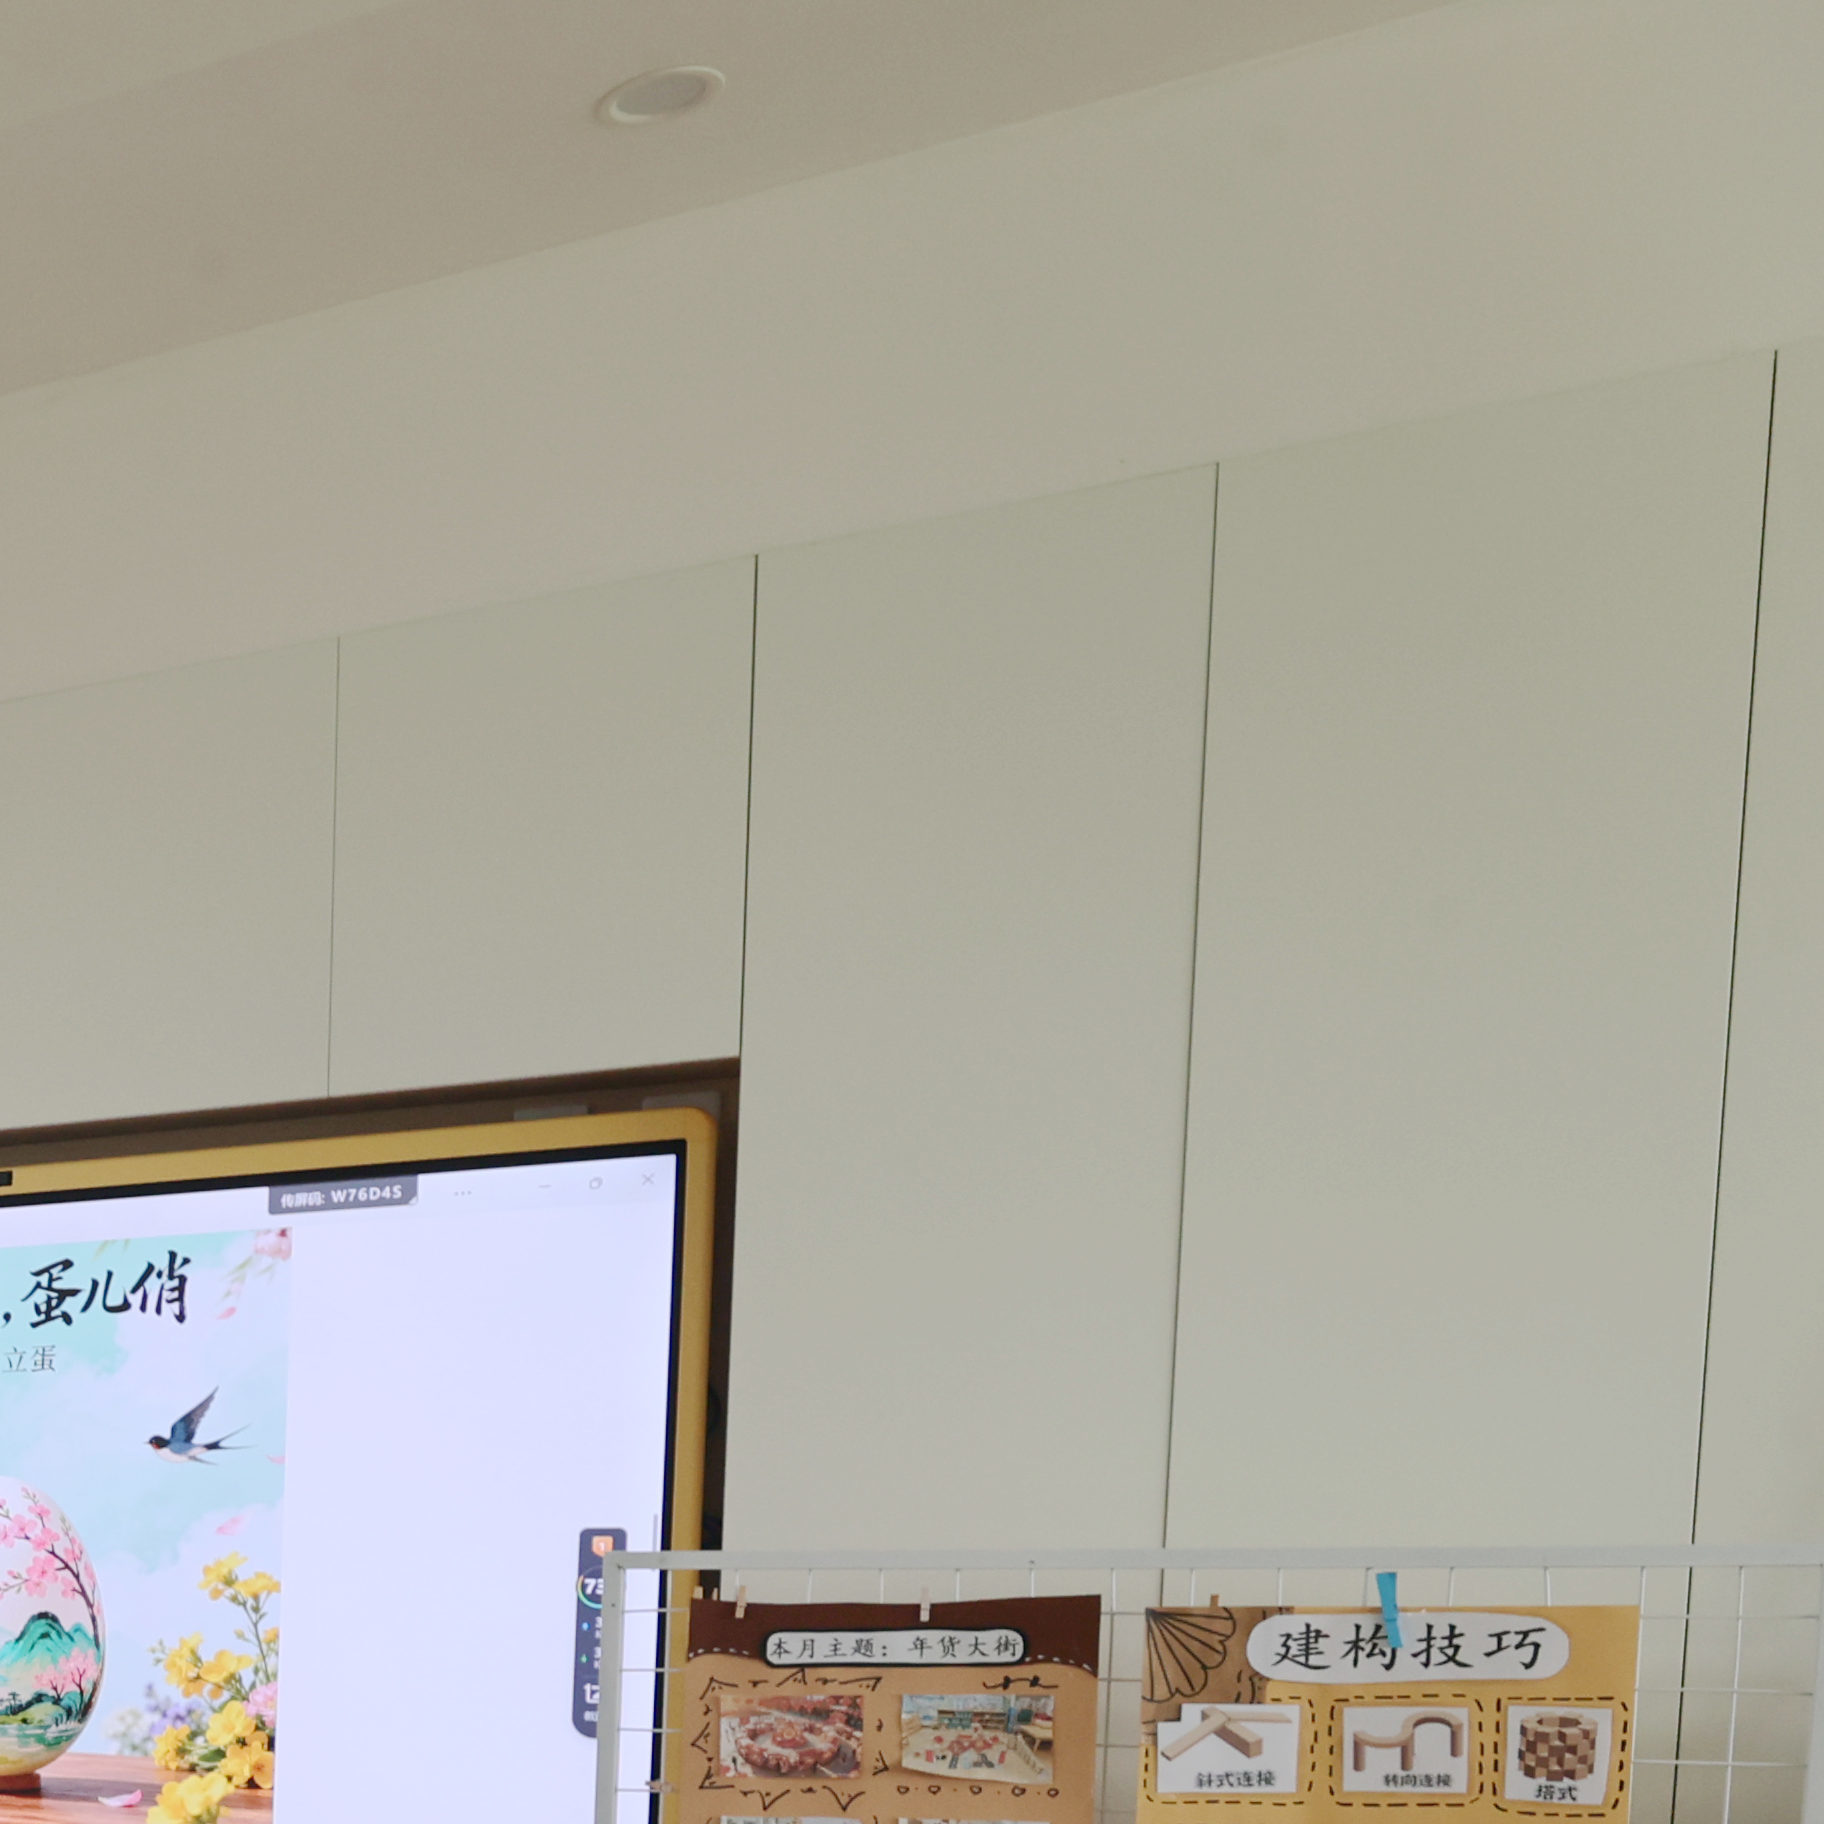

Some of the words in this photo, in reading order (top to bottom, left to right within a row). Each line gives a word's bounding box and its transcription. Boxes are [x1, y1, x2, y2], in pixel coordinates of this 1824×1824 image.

[331, 1184, 403, 1204] W76D4S
[1270, 1622, 1547, 1671] 建构技巧
[1196, 1771, 1276, 1789] 斜式连接
[1383, 1773, 1453, 1789] 转向连接
[1535, 1784, 1578, 1802] 塔式
